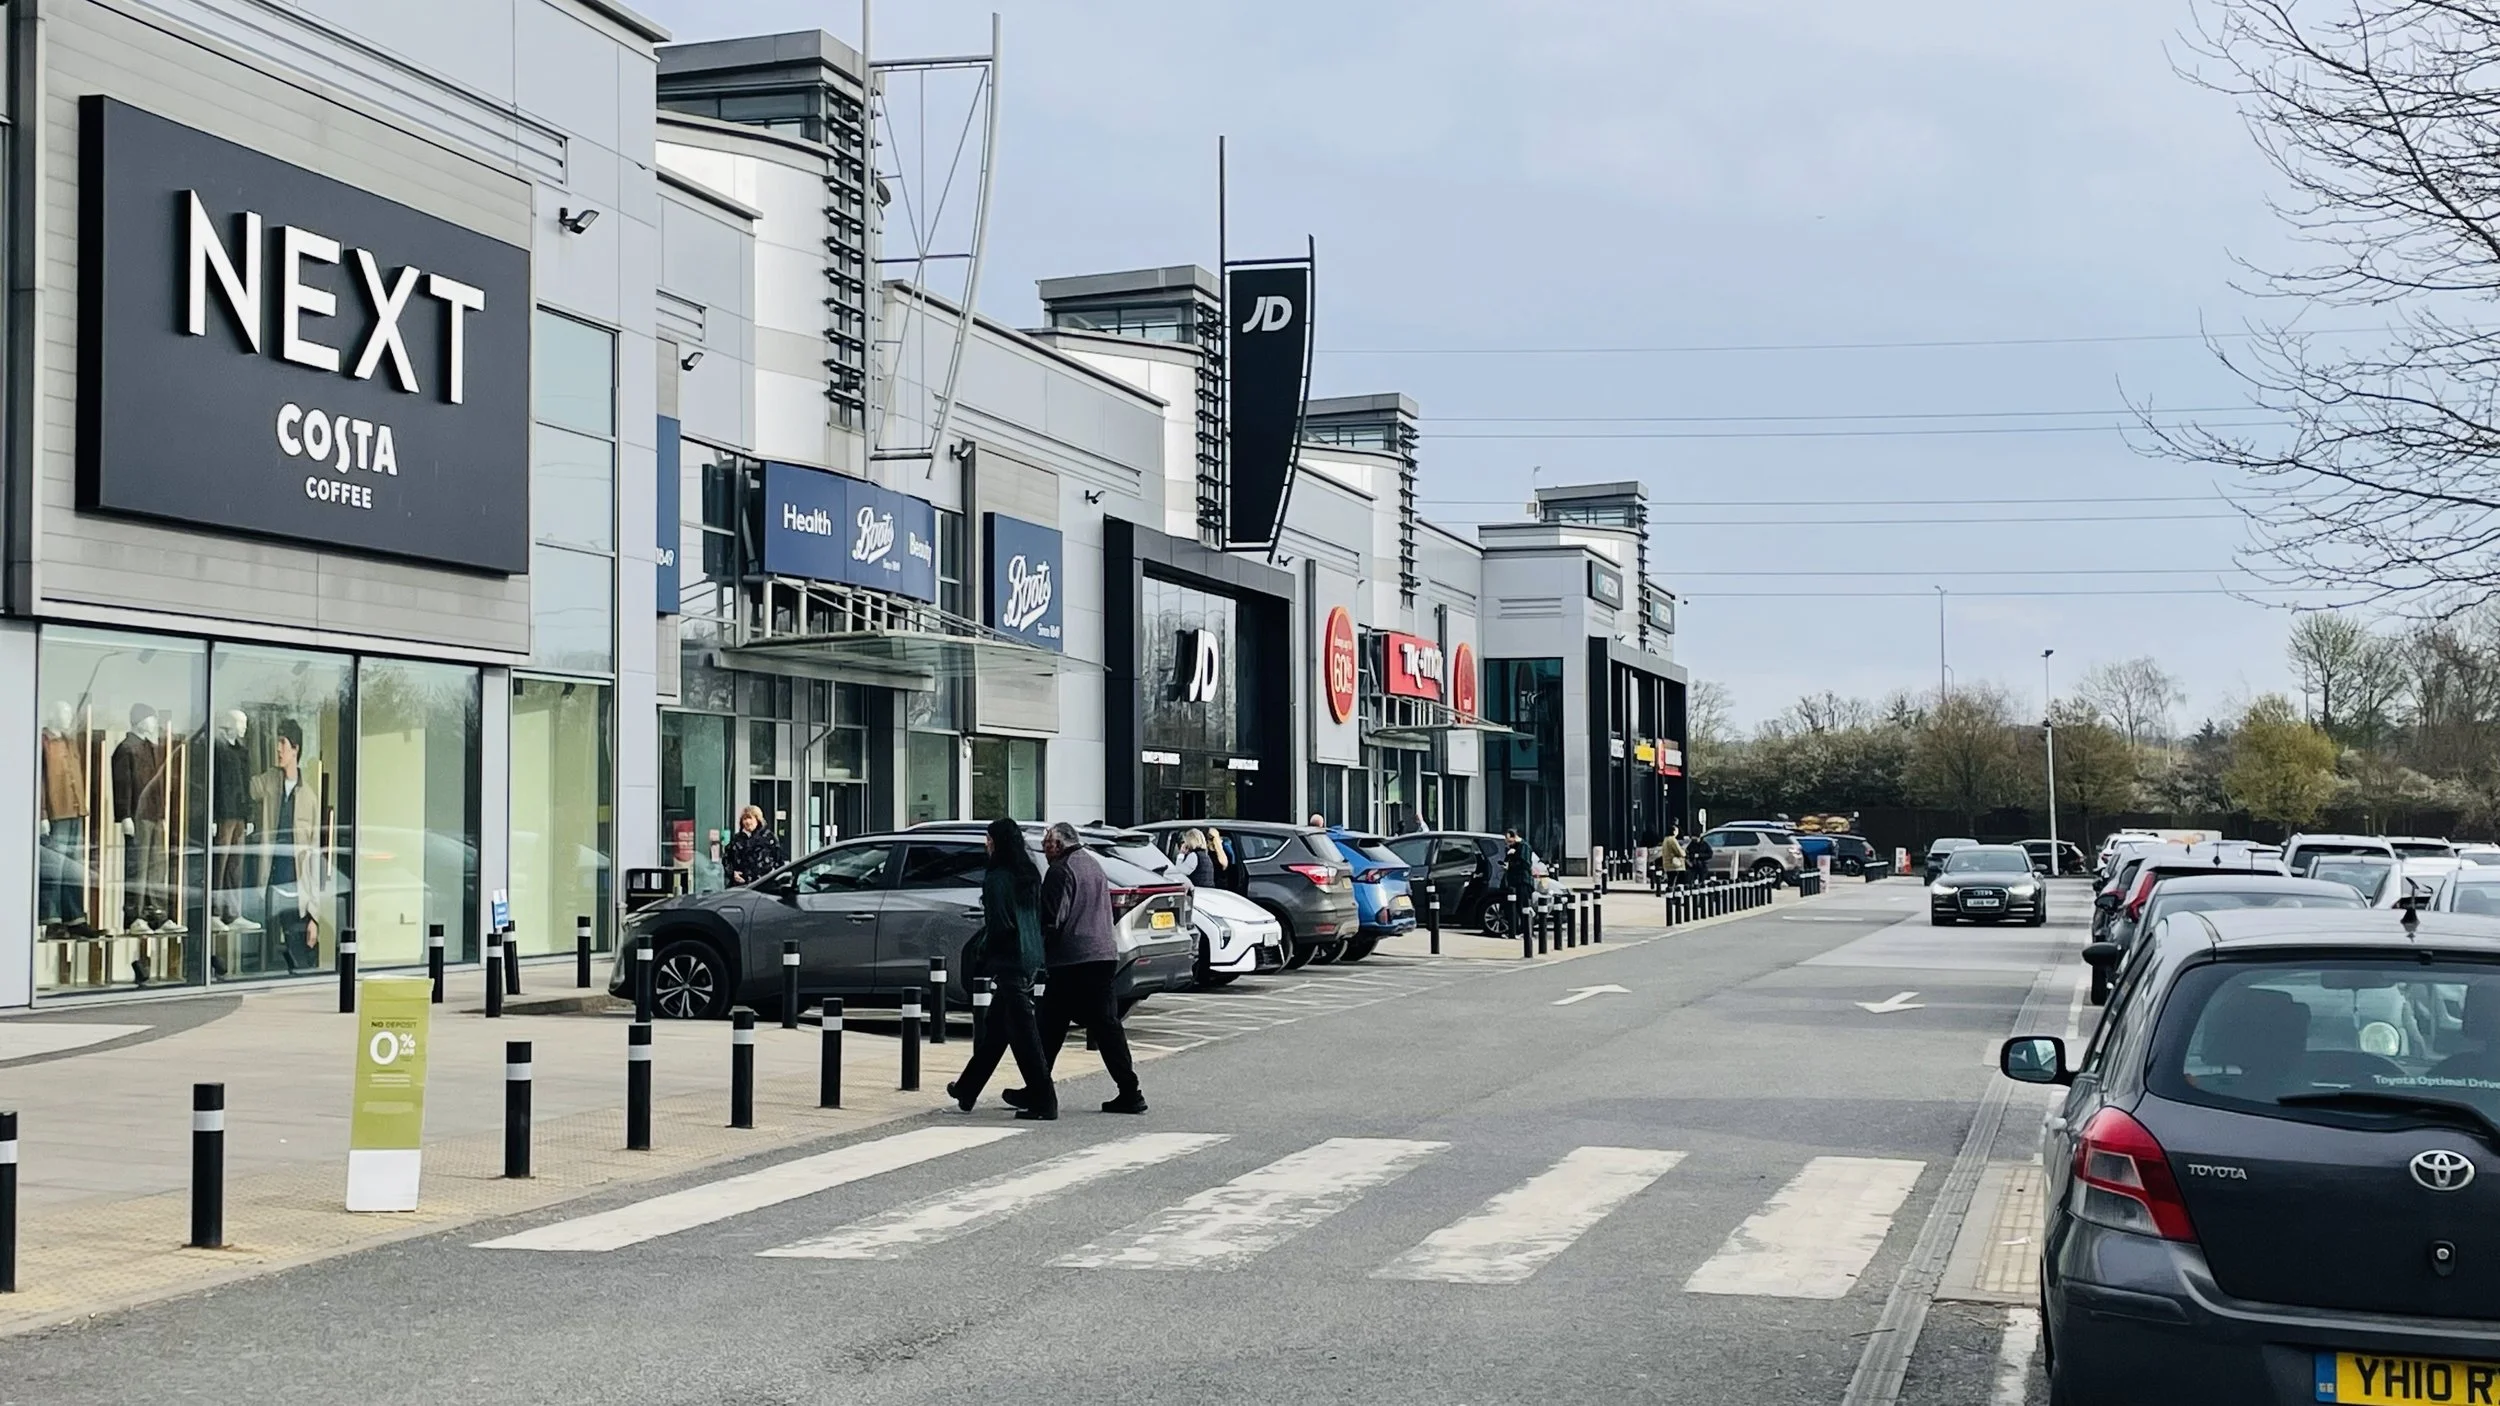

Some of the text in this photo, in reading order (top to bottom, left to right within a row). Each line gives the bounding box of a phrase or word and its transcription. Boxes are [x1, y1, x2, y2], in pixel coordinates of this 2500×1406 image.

[186, 188, 485, 405] NEXT
[1242, 296, 1293, 334] JD
[276, 402, 398, 476] COSTA
[304, 475, 373, 510] COFFEE
[783, 502, 832, 536] Health
[851, 506, 895, 565] Boots
[909, 531, 932, 568] Beauty
[1003, 554, 1052, 632] Boots
[1187, 628, 1220, 703] JD
[371, 1021, 417, 1029] NO DEPOSIT
[2373, 1074, 2416, 1087] Toyota
[2417, 1075, 2467, 1088] Optimal
[2188, 1164, 2248, 1180] TOYOTA
[2467, 1364, 2500, 1406] R
